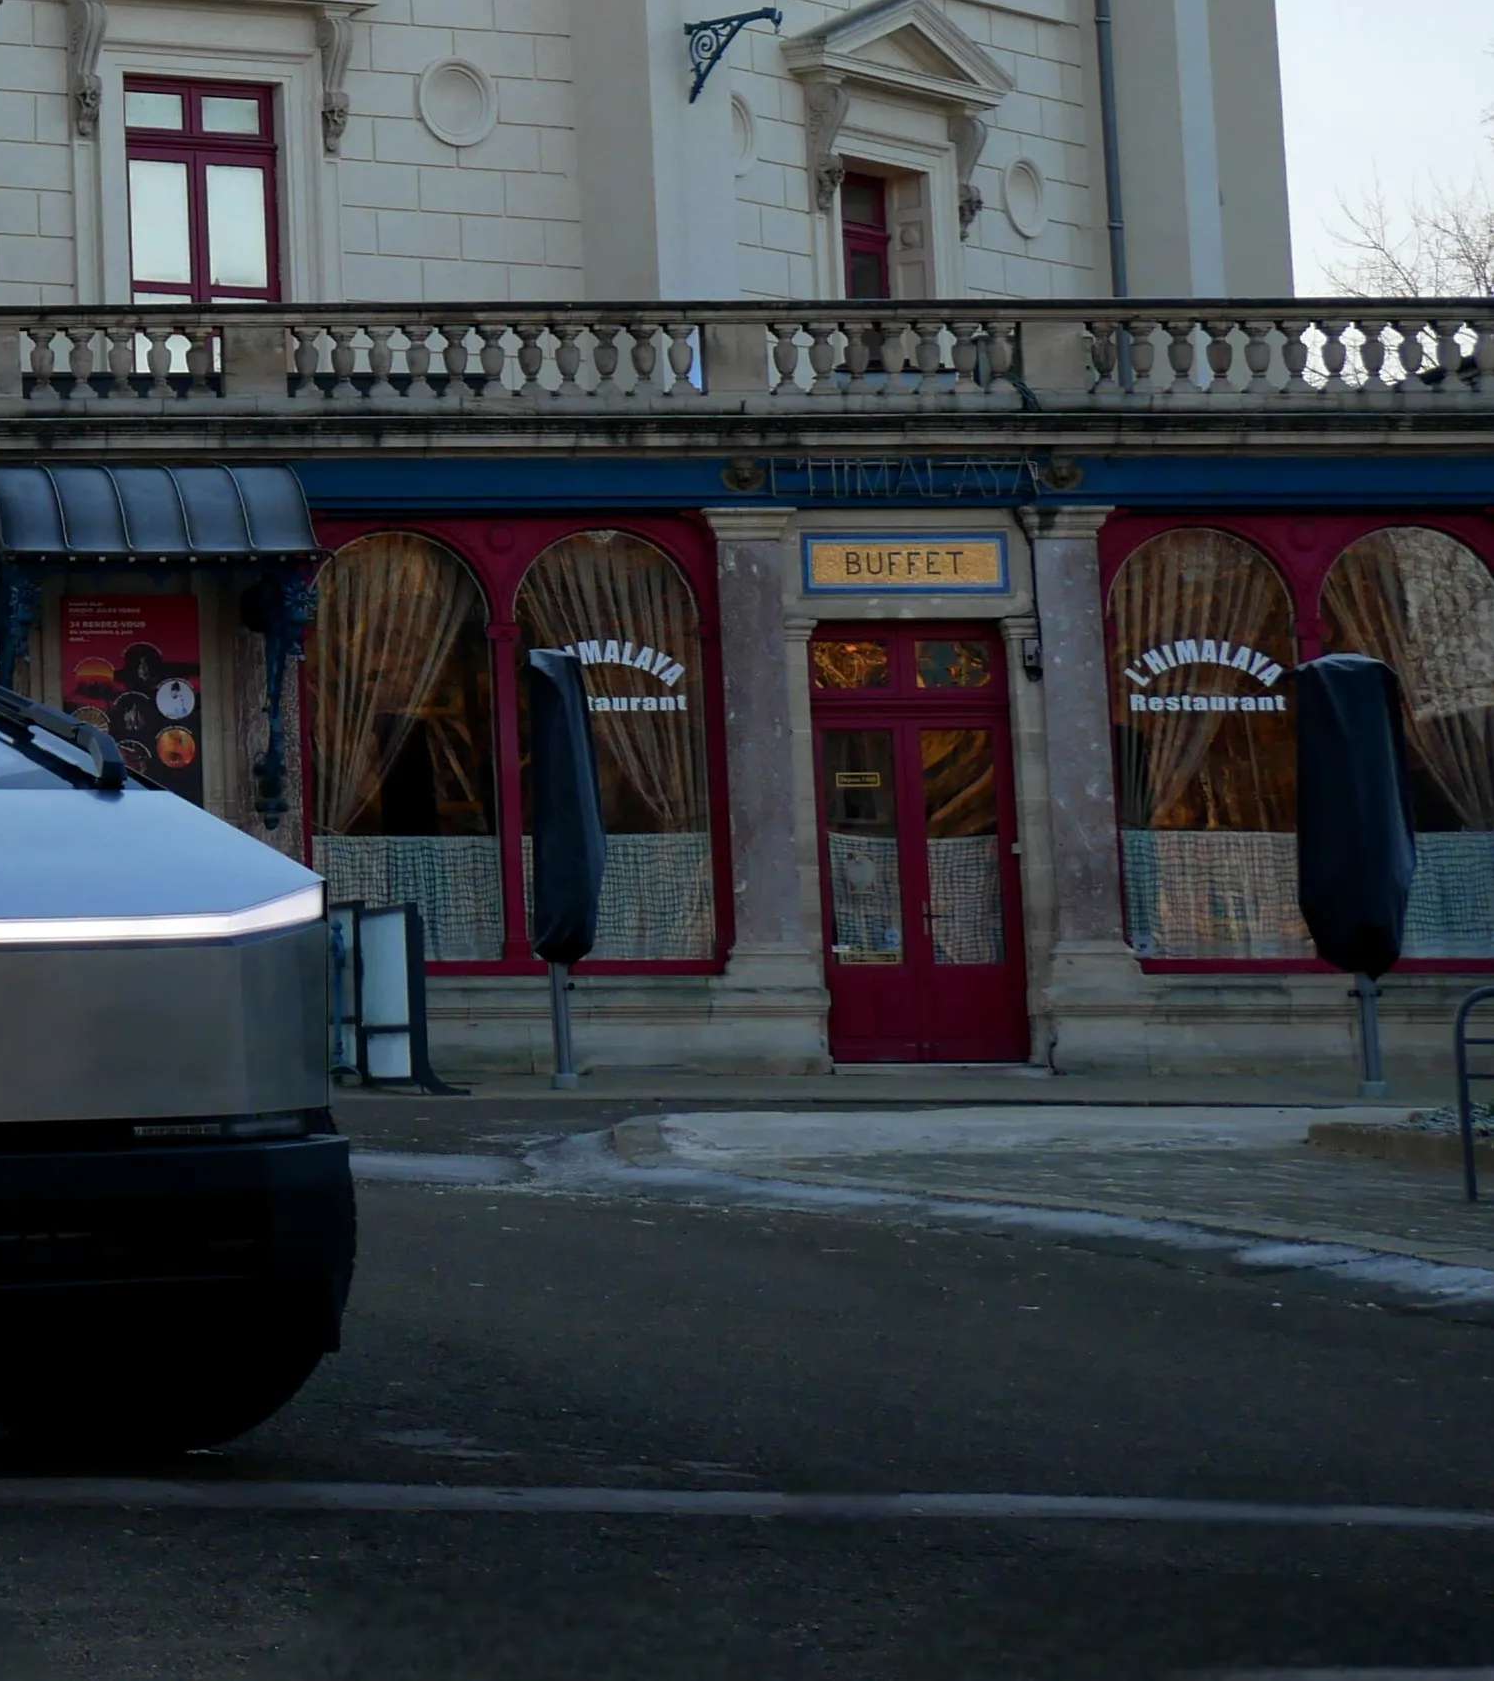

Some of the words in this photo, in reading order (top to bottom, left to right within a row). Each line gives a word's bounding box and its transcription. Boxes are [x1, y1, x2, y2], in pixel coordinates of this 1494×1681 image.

[845, 551, 964, 575] BUFFET
[564, 639, 685, 687] MALAYA
[1124, 639, 1283, 687] L'HIMALAYA
[587, 694, 688, 711] taurant
[1129, 694, 1287, 711] Restaurant
